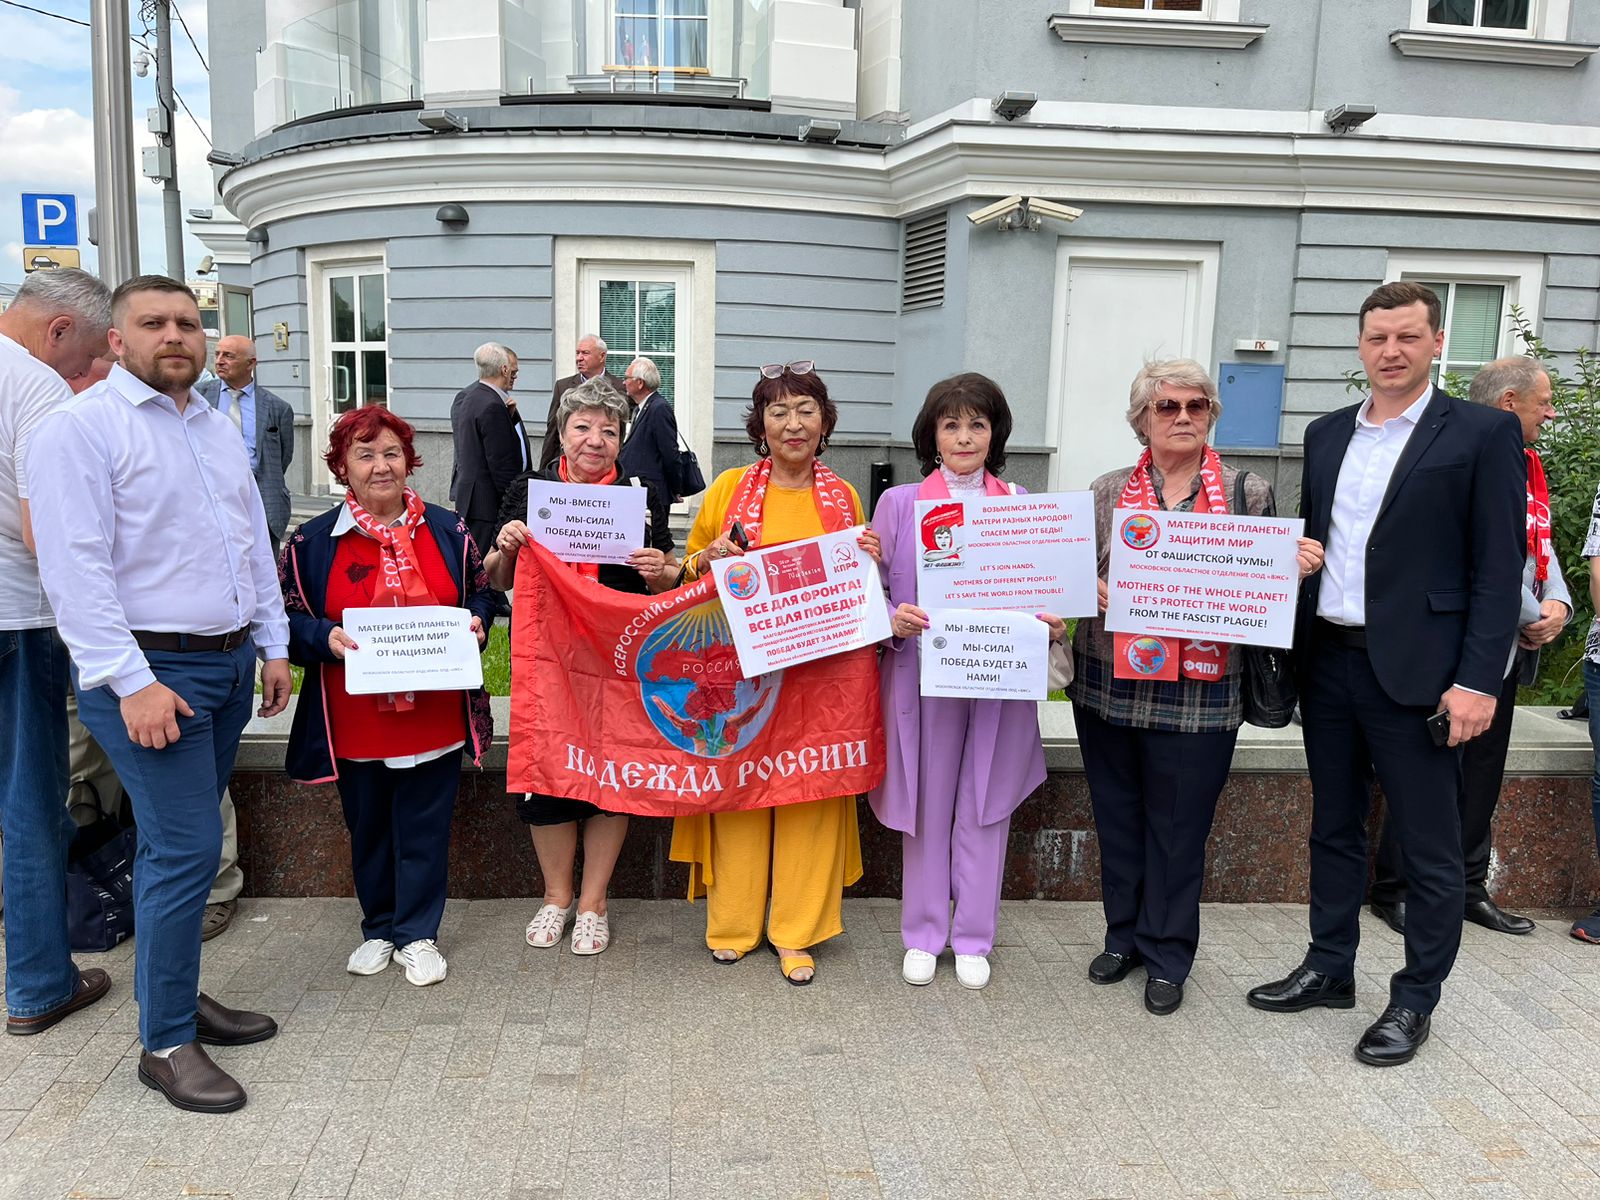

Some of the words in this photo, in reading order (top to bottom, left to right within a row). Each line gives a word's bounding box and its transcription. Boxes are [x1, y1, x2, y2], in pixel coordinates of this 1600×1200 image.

[36, 198, 67, 240] P
[1255, 341, 1266, 350] ПК
[549, 496, 567, 505] МЫ
[982, 504, 1027, 513] ВОЗЬМЕМСЯ
[566, 515, 614, 526] МЫ-СИЛА!
[972, 518, 1001, 526] МАТЕРИ
[1032, 514, 1073, 522] НАРОДОВ!!
[545, 527, 582, 538] ПОБЕДА
[584, 530, 612, 540] БУДЕТ
[980, 529, 1010, 538] СПАСЕМ
[1011, 528, 1028, 536] МИР
[1040, 526, 1063, 535] БЕДЫ!
[1167, 520, 1208, 530] МАТЕРИ
[1210, 522, 1235, 532] ВСЕЙ
[1238, 524, 1290, 535] ПЛАНЕТЫ!
[569, 542, 601, 551] НАМИ!
[1168, 535, 1225, 547] ЗАЩИТИМ
[1228, 538, 1254, 548] МИР
[1145, 550, 1160, 559] ОТ
[1161, 551, 1234, 565] ФАШИСТСКОЙ
[1236, 556, 1274, 567] ЧУМЫ!
[834, 561, 859, 574] КПРФ
[1129, 564, 1172, 572] МОСКОВСКОЕ
[1173, 567, 1210, 575] ОБЛАСТНОЕ
[1211, 570, 1250, 578] ОТДЕЛЕНИЕ
[1250, 572, 1266, 580] ООД
[744, 603, 768, 616] ВСЕ
[771, 595, 799, 612] ДЛЯ
[800, 579, 862, 602] ФРОНТА!
[1117, 580, 1165, 592] MOTHERS
[1167, 584, 1180, 594] OF
[1184, 585, 1202, 596] THE
[1204, 588, 1242, 600] WHOLE
[1244, 590, 1288, 602] PLANET!
[1160, 597, 1204, 610] PROTECT
[1208, 601, 1226, 611] THE
[1228, 603, 1268, 614] WORLD
[748, 618, 773, 633] ВСЕ
[775, 611, 802, 628] ДЛЯ
[804, 594, 866, 619] ПОБЕДЫ!
[1129, 608, 1159, 619] FROM
[1162, 610, 1180, 621] THE
[1182, 612, 1221, 624] FASCIST
[1223, 616, 1268, 629] PLAGUE!
[358, 624, 394, 632] МАТЕРИ
[395, 621, 416, 631] ВСЕЙ
[418, 620, 460, 629] ПЛАНЕТЫ!
[944, 624, 963, 632] МЫ
[371, 634, 424, 644] ЗАЩИТИМ
[427, 632, 450, 640] МИР
[766, 644, 796, 657] ПОБЕДА
[796, 636, 820, 649] БУДЕТ
[832, 627, 859, 639] НАМИ!
[376, 649, 390, 657] ОТ
[392, 646, 447, 658] НАЦИЗМА!
[962, 644, 1014, 653] МЫ-СИЛА!
[682, 658, 740, 674] РОССИЯ
[940, 658, 980, 668] ПОБЕДА
[982, 660, 1014, 670] БУДЕТ
[1016, 661, 1028, 670] ЗА
[966, 673, 1000, 682] НАМИ!
[564, 743, 724, 797] НАДЕЖДА
[736, 740, 868, 788] РОССИИ
